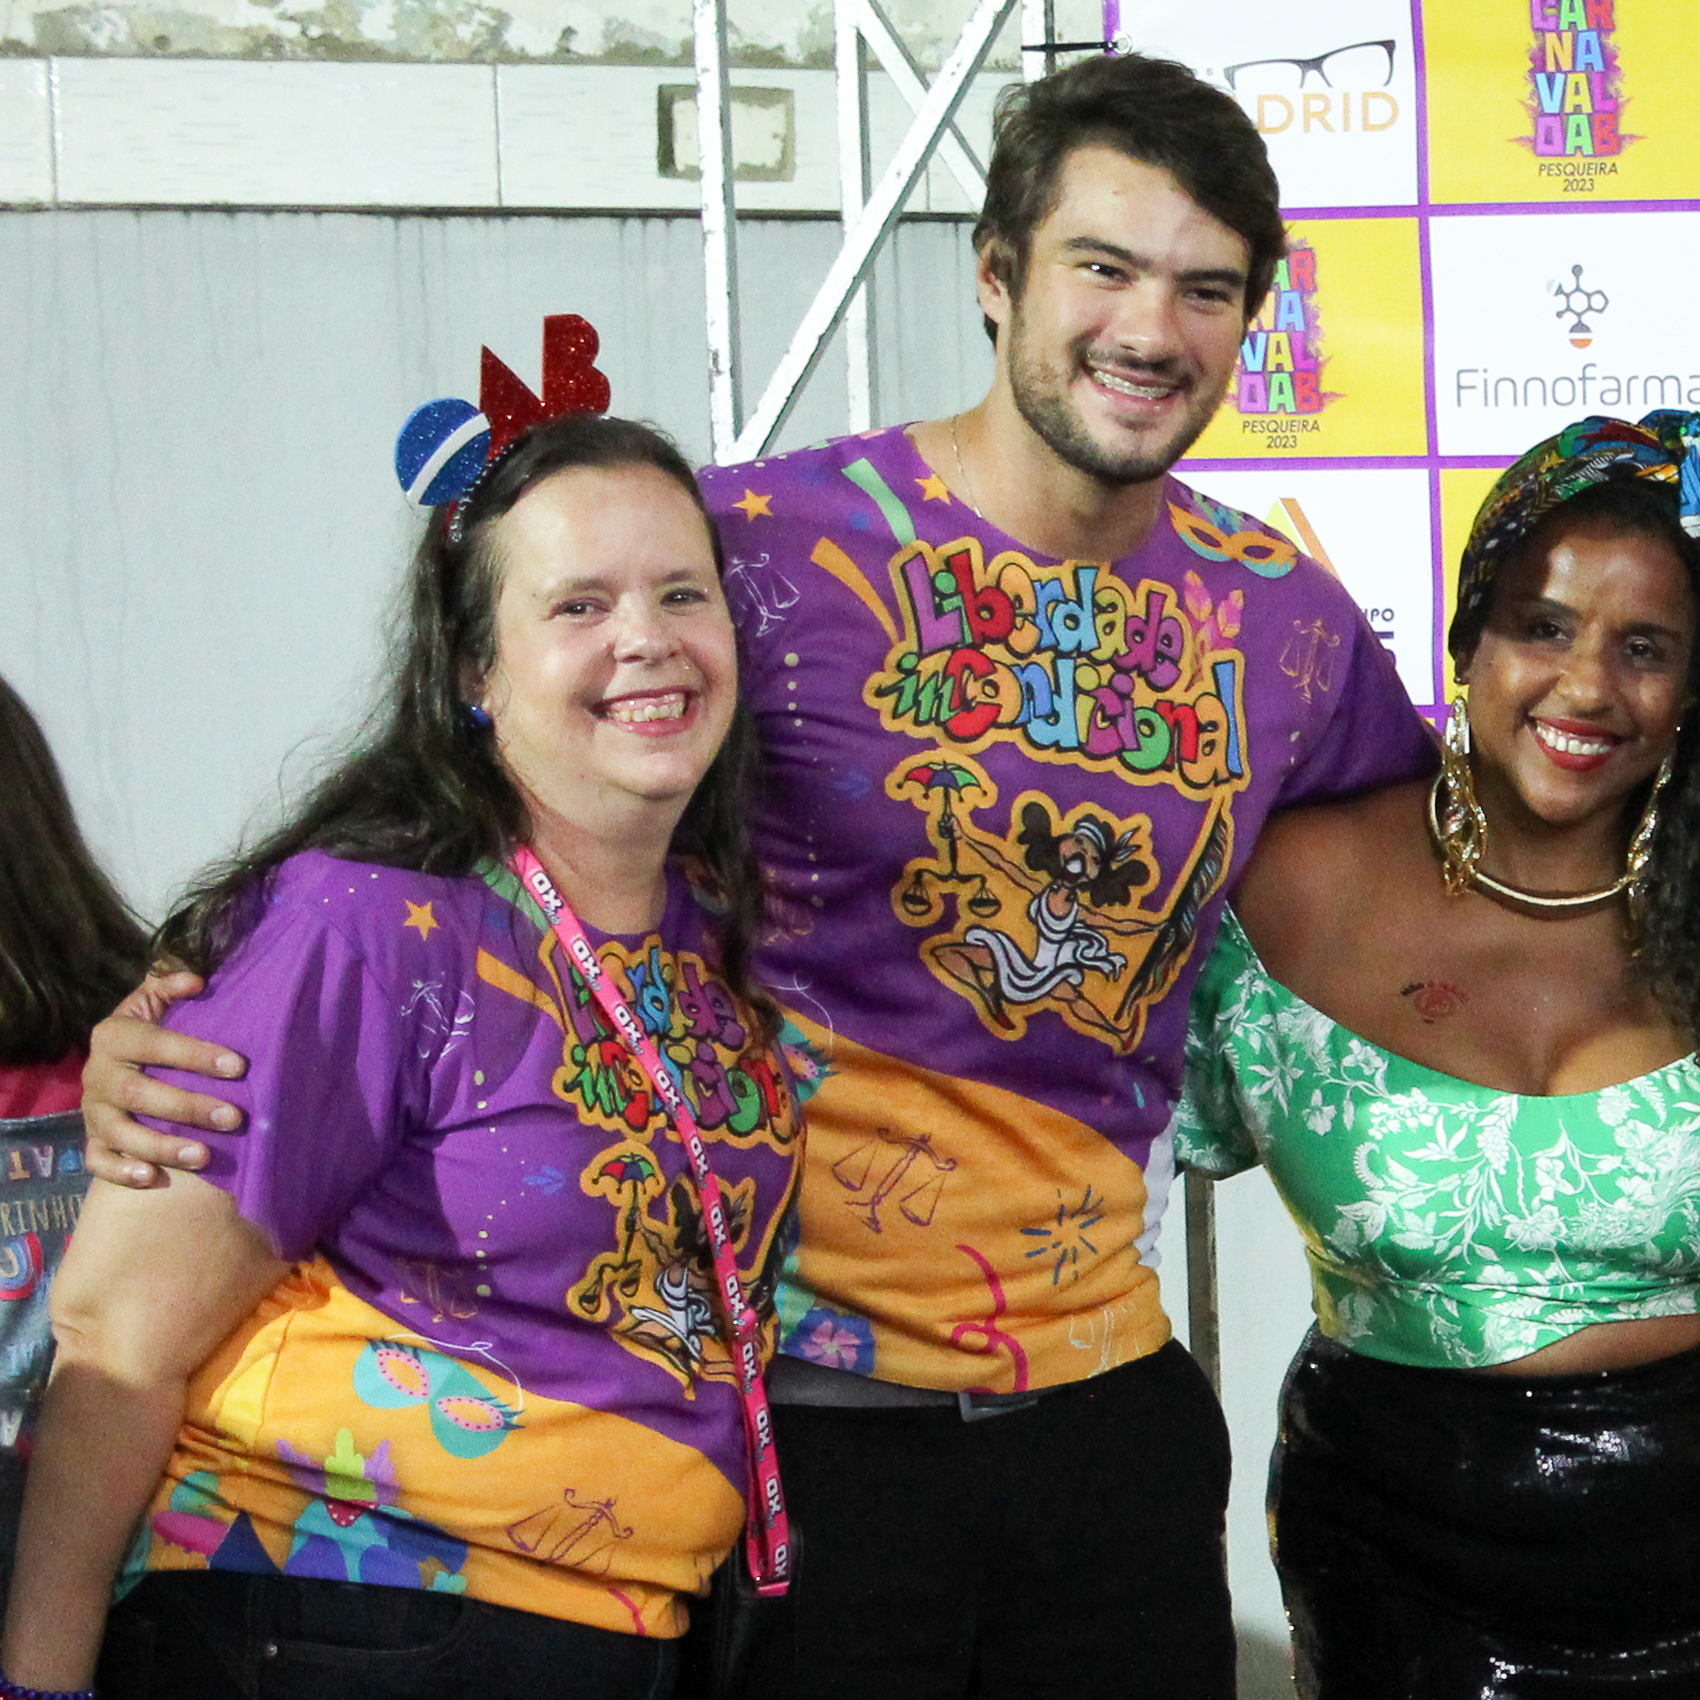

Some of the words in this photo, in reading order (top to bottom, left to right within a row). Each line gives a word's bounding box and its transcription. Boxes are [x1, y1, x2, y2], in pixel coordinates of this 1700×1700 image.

[1545, 30, 1604, 72] NA
[1257, 91, 1399, 134] DRID
[1535, 73, 1618, 113] VAL
[1535, 115, 1621, 156] OAB
[1538, 162, 1619, 177] PESQUEIRA
[1563, 179, 1595, 192] 2023
[1273, 249, 1318, 292] AR
[1241, 331, 1319, 372] VAL
[1238, 372, 1323, 414] OAB
[1242, 420, 1321, 434] PESQUEIRA
[1266, 435, 1298, 449] 2023
[900, 550, 1182, 690] Liberdade
